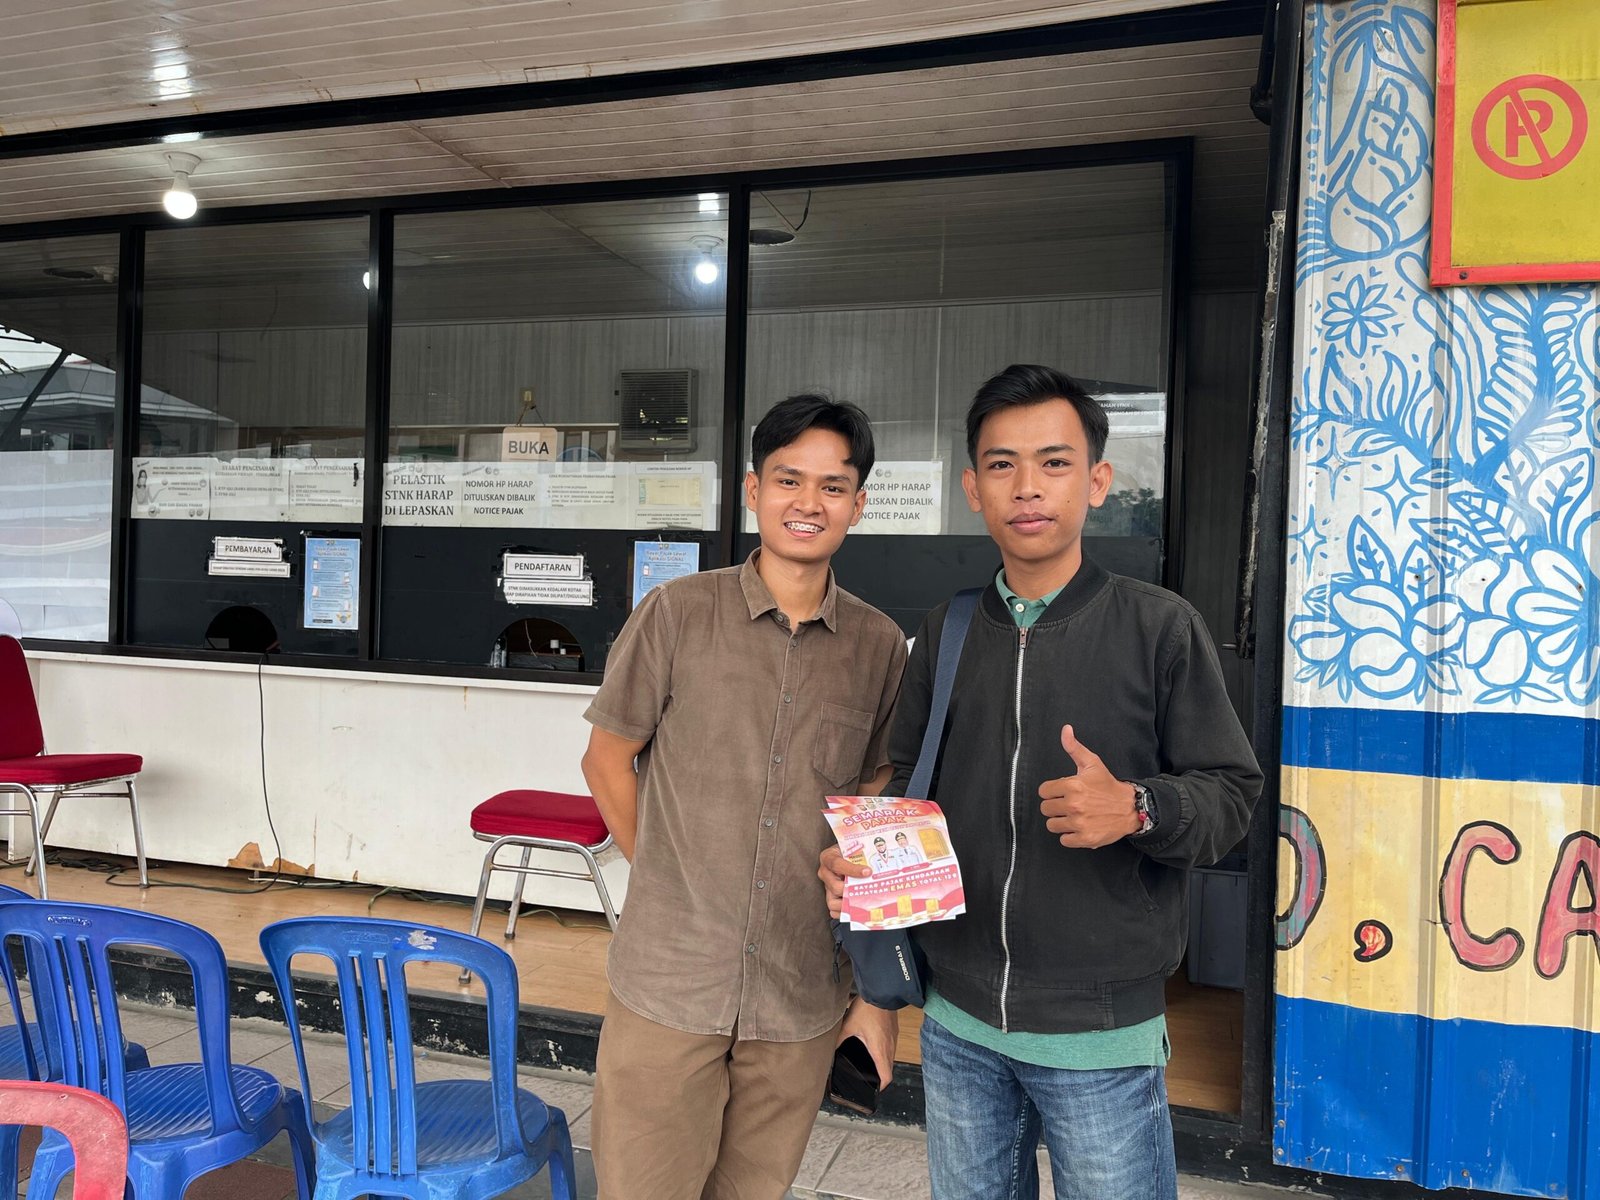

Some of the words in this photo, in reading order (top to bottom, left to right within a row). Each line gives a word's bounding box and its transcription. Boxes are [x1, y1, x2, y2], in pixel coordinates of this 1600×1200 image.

[508, 441, 549, 454] BUKA
[393, 474, 446, 485] PELASTIK
[465, 480, 494, 488] NOMOR
[384, 490, 414, 500] STNK
[416, 490, 454, 500] HARAP
[506, 494, 536, 502] DIBALIK
[900, 498, 934, 506] DIBALIK
[384, 506, 396, 516] DI
[399, 506, 454, 516] LEPASKAN
[501, 507, 524, 515] PAJAK
[894, 512, 920, 520] PAJAK
[225, 545, 272, 554] PEMBAYARAN
[514, 562, 572, 571] PENDAFTARAN
[843, 809, 917, 826] SEMARAK
[860, 816, 907, 830] PAJAK
[881, 878, 903, 886] PAJAK
[906, 868, 950, 880] KENDARAAN
[848, 887, 888, 896] DAPATKAN
[890, 881, 917, 892] EMAS
[919, 876, 942, 884] TOTAL
